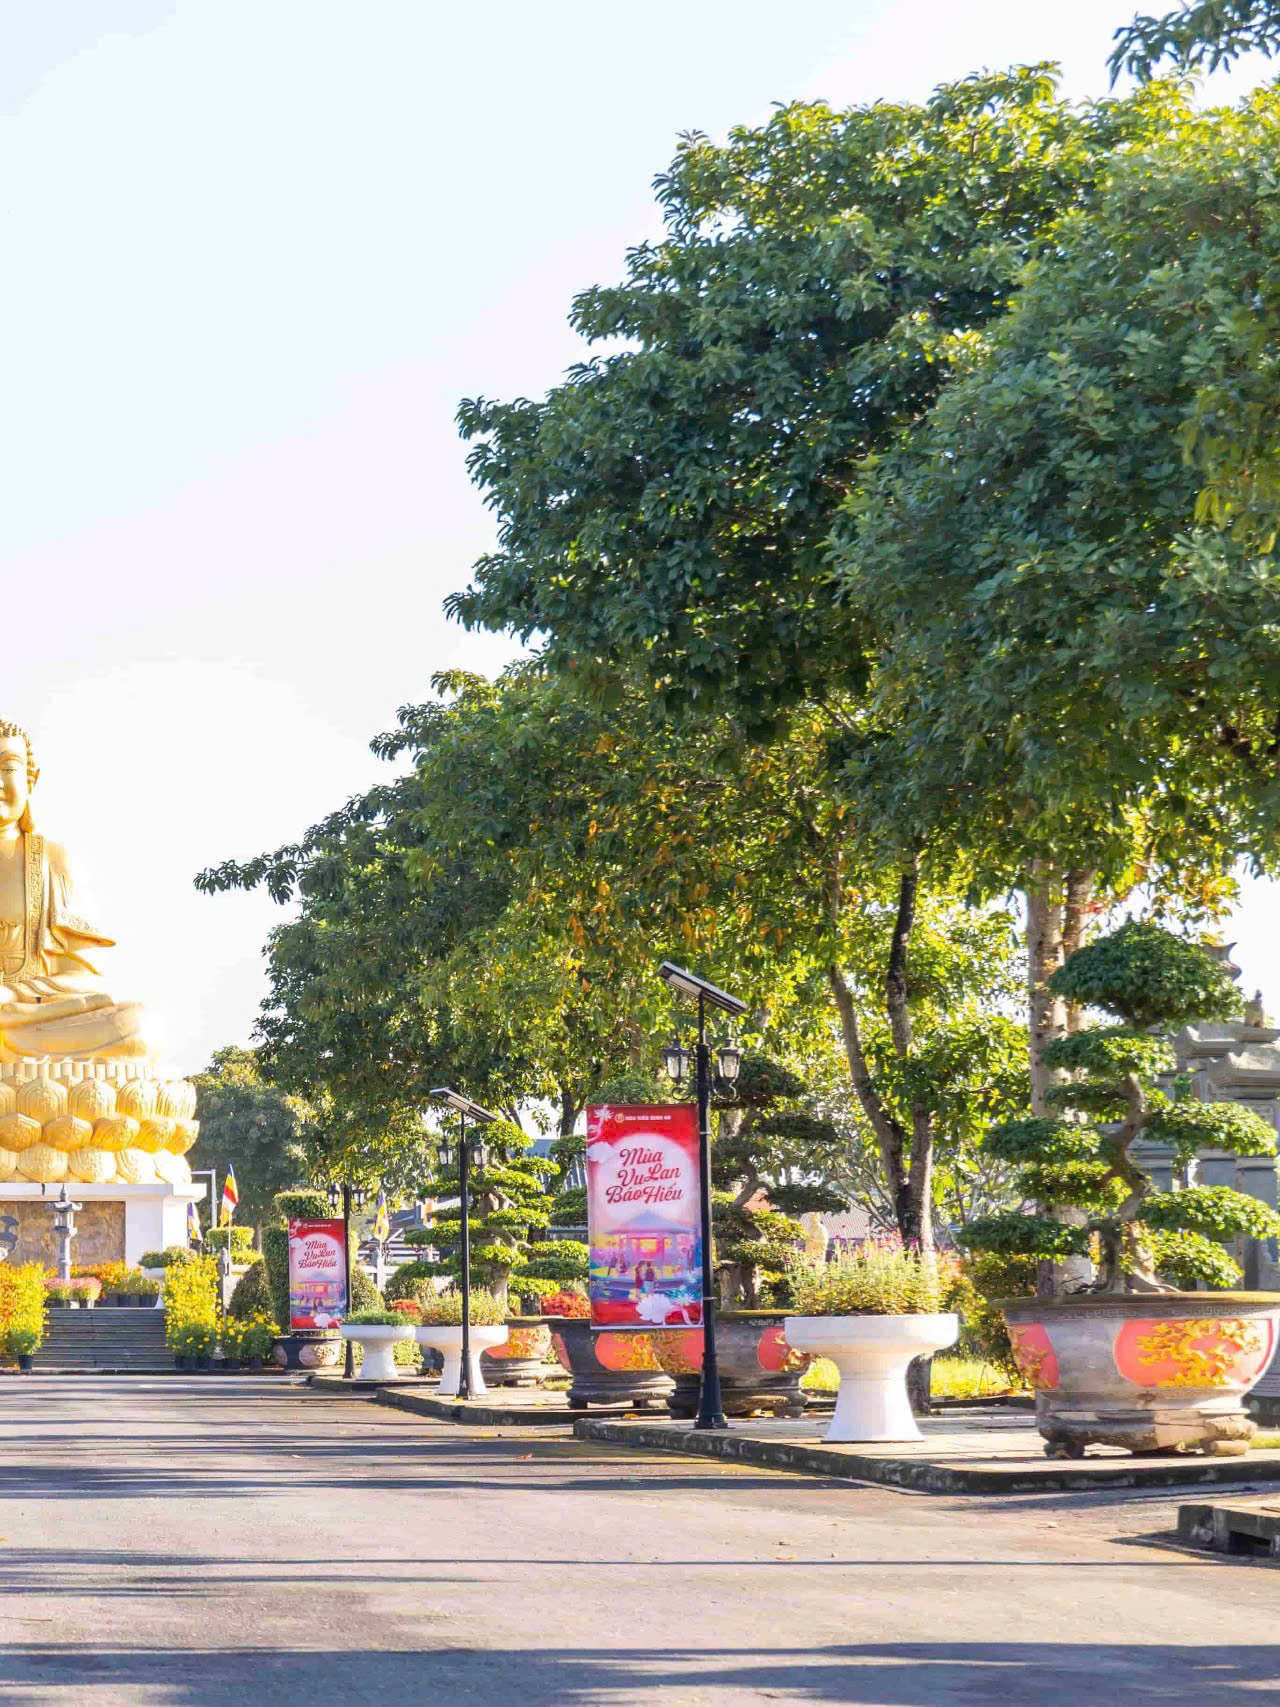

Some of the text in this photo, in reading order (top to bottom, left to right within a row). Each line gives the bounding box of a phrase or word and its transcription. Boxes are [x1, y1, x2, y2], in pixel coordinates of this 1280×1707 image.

[619, 1147, 663, 1166] Mùa
[617, 1163, 680, 1187] Vu Lan
[605, 1182, 683, 1204] Báo Hiếu
